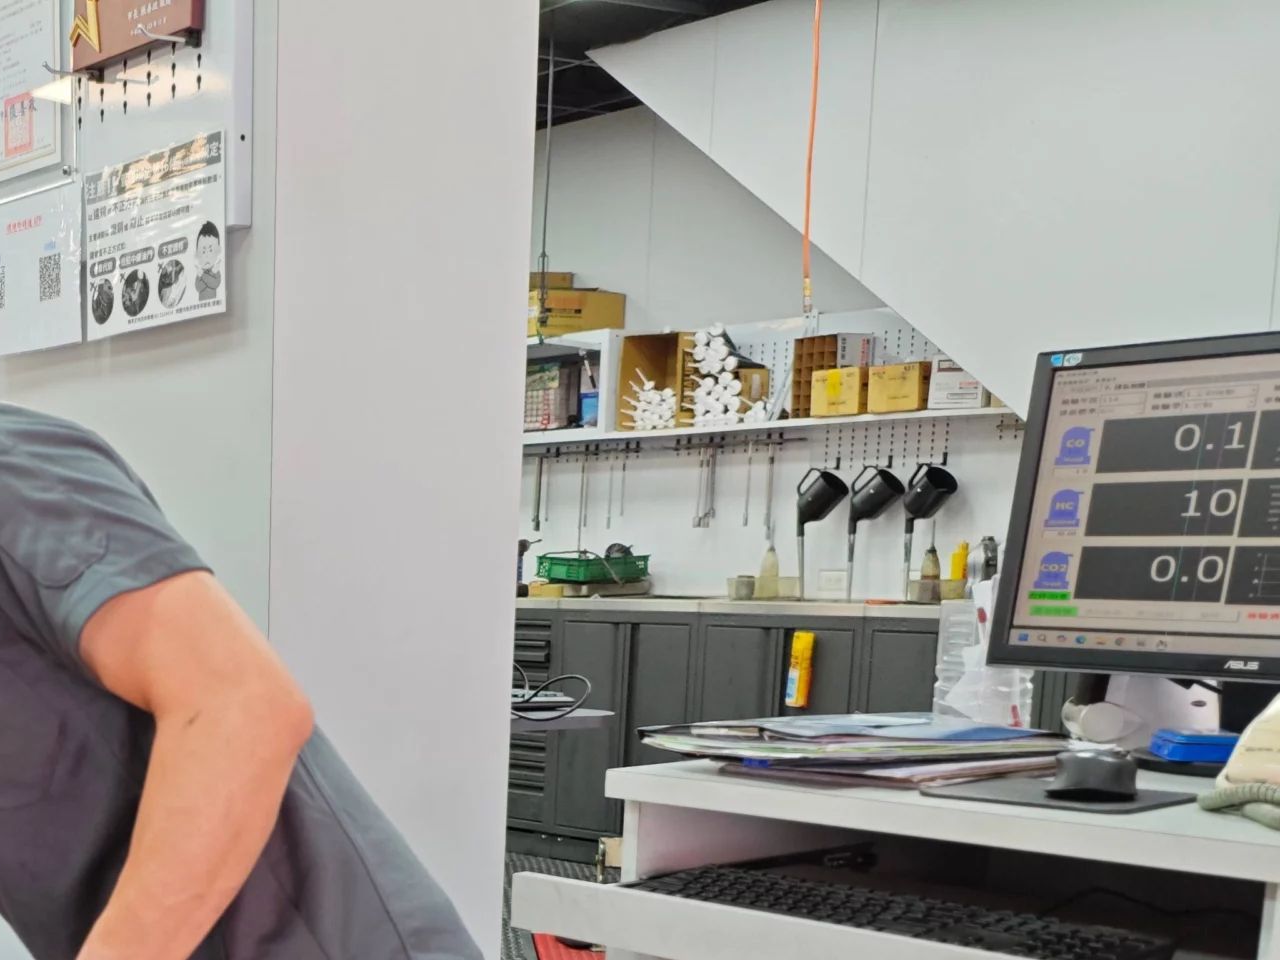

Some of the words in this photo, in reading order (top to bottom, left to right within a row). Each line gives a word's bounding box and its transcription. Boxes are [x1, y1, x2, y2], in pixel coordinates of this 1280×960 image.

[1065, 439, 1085, 448] CO
[1174, 421, 1245, 451] 0.1
[1181, 488, 1238, 517] 10
[1040, 563, 1068, 573] CO2
[1150, 556, 1224, 583] 0.0
[1224, 660, 1260, 670] ASUS
